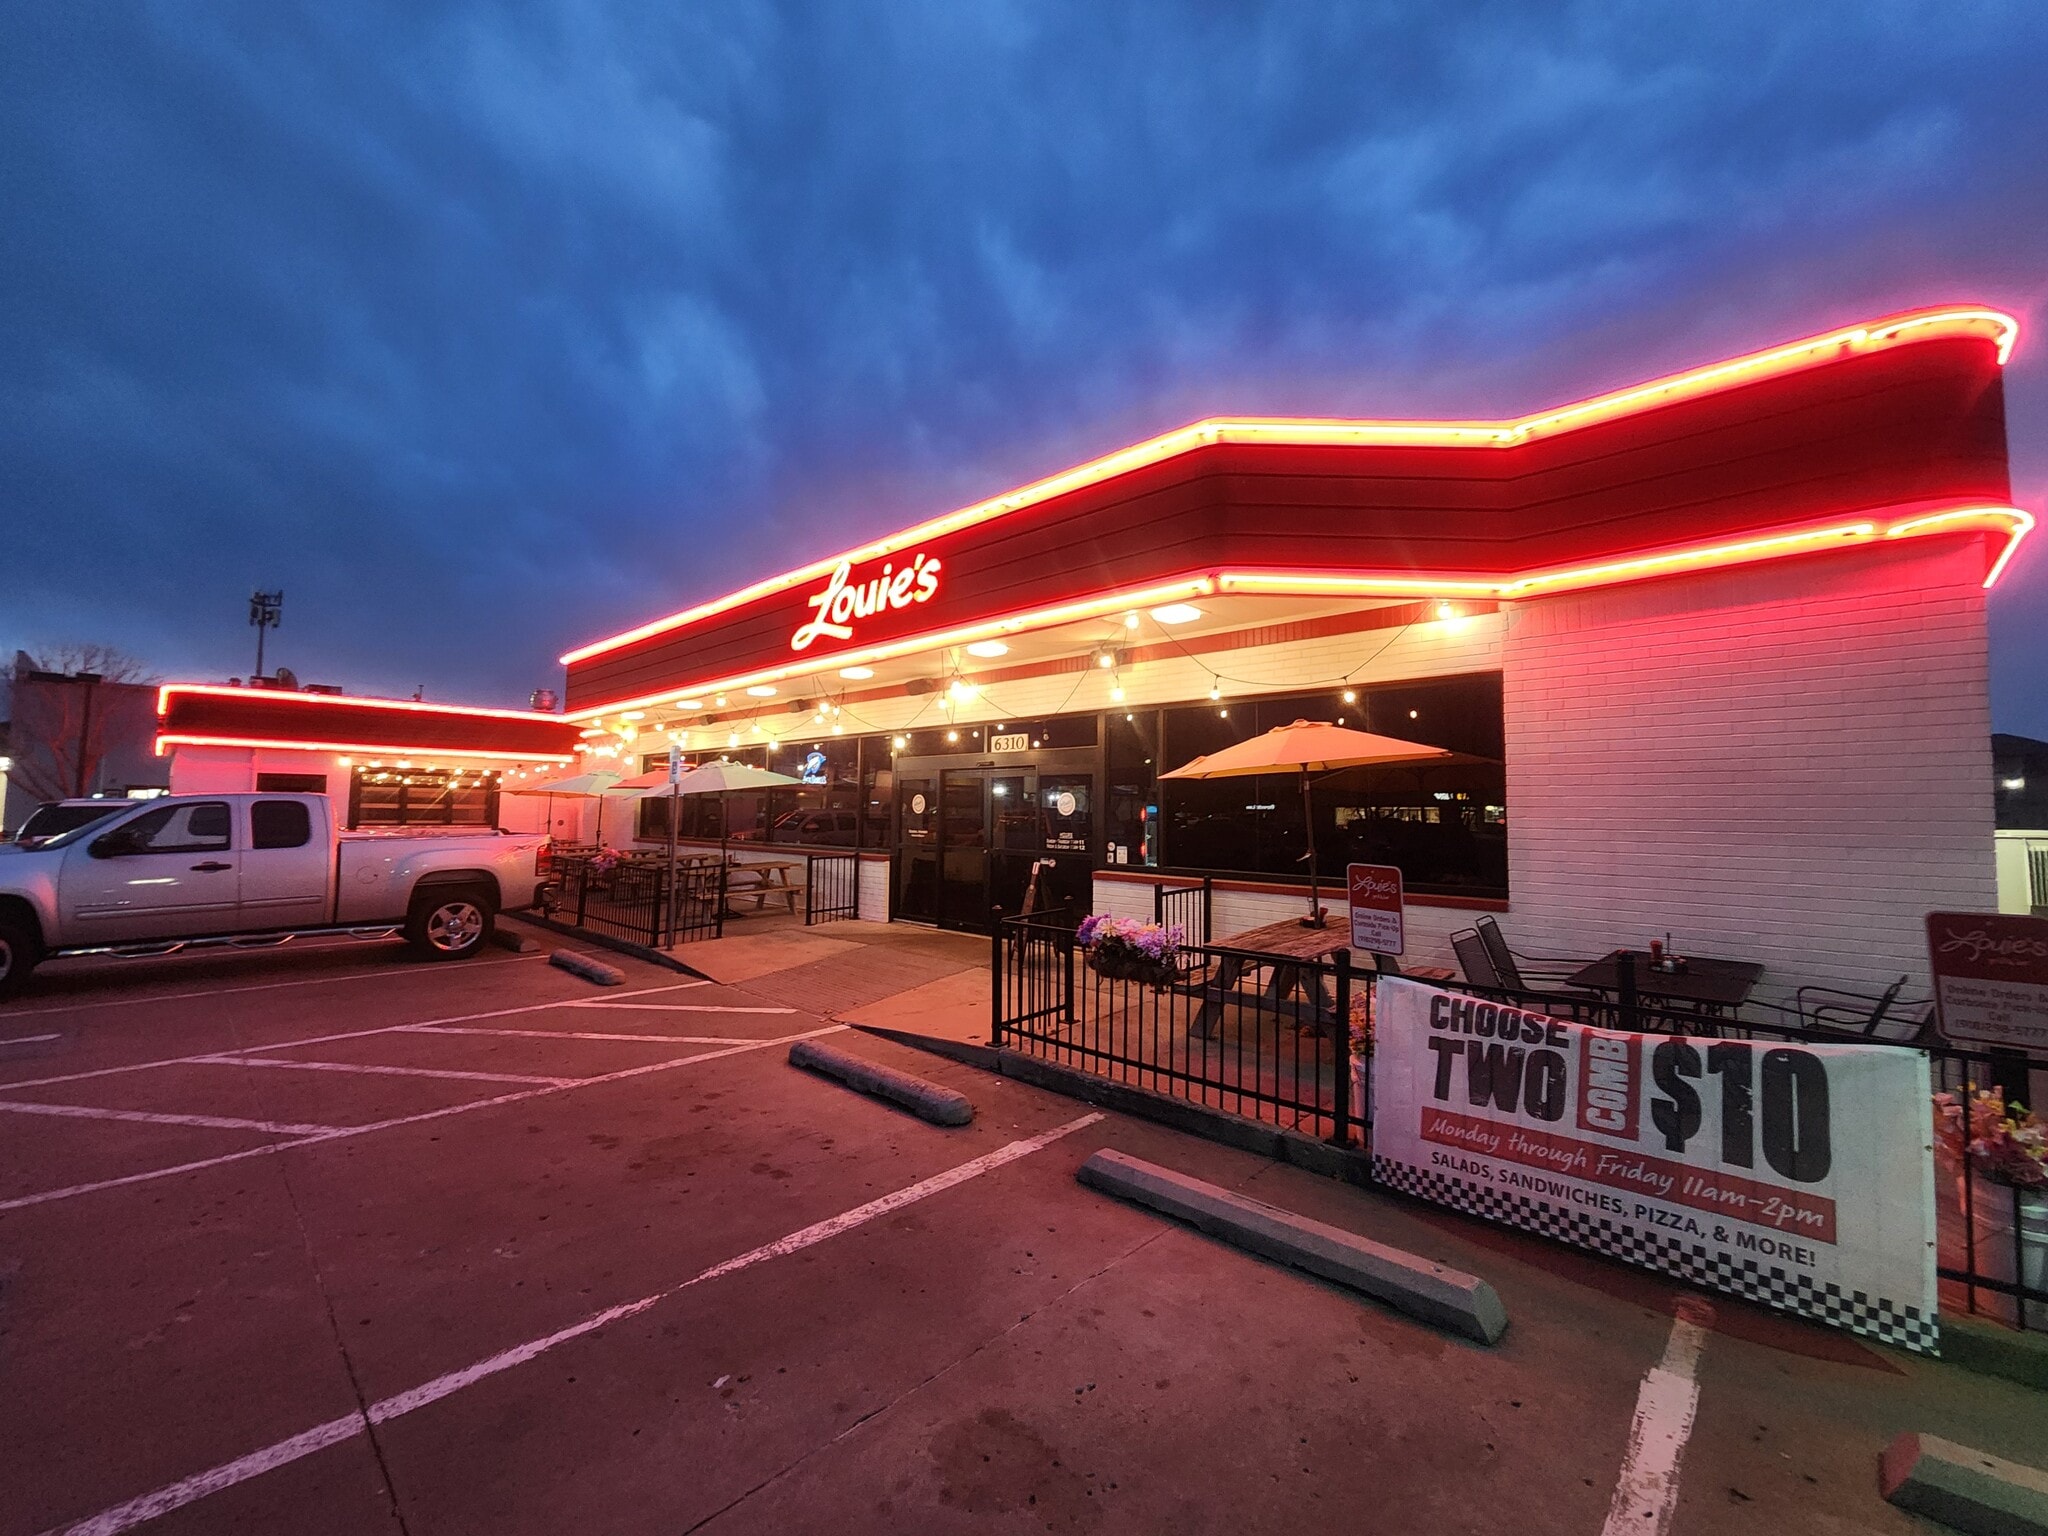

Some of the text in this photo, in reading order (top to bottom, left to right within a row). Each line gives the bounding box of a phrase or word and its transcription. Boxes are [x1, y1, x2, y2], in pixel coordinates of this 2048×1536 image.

[791, 553, 941, 650] Louie's
[994, 736, 1025, 751] 6310
[1352, 874, 1397, 897] Louie's
[1939, 928, 2048, 961] Louie's
[1429, 995, 1570, 1049] CHOOSE
[1428, 1036, 1567, 1122] TWO
[1651, 1036, 1832, 1183] $10
[1429, 1118, 1825, 1227] Monday through Friday 11am-2pm
[1431, 1151, 1816, 1267] SALADS, SANDWICHES, PIZZA, & MORE!
